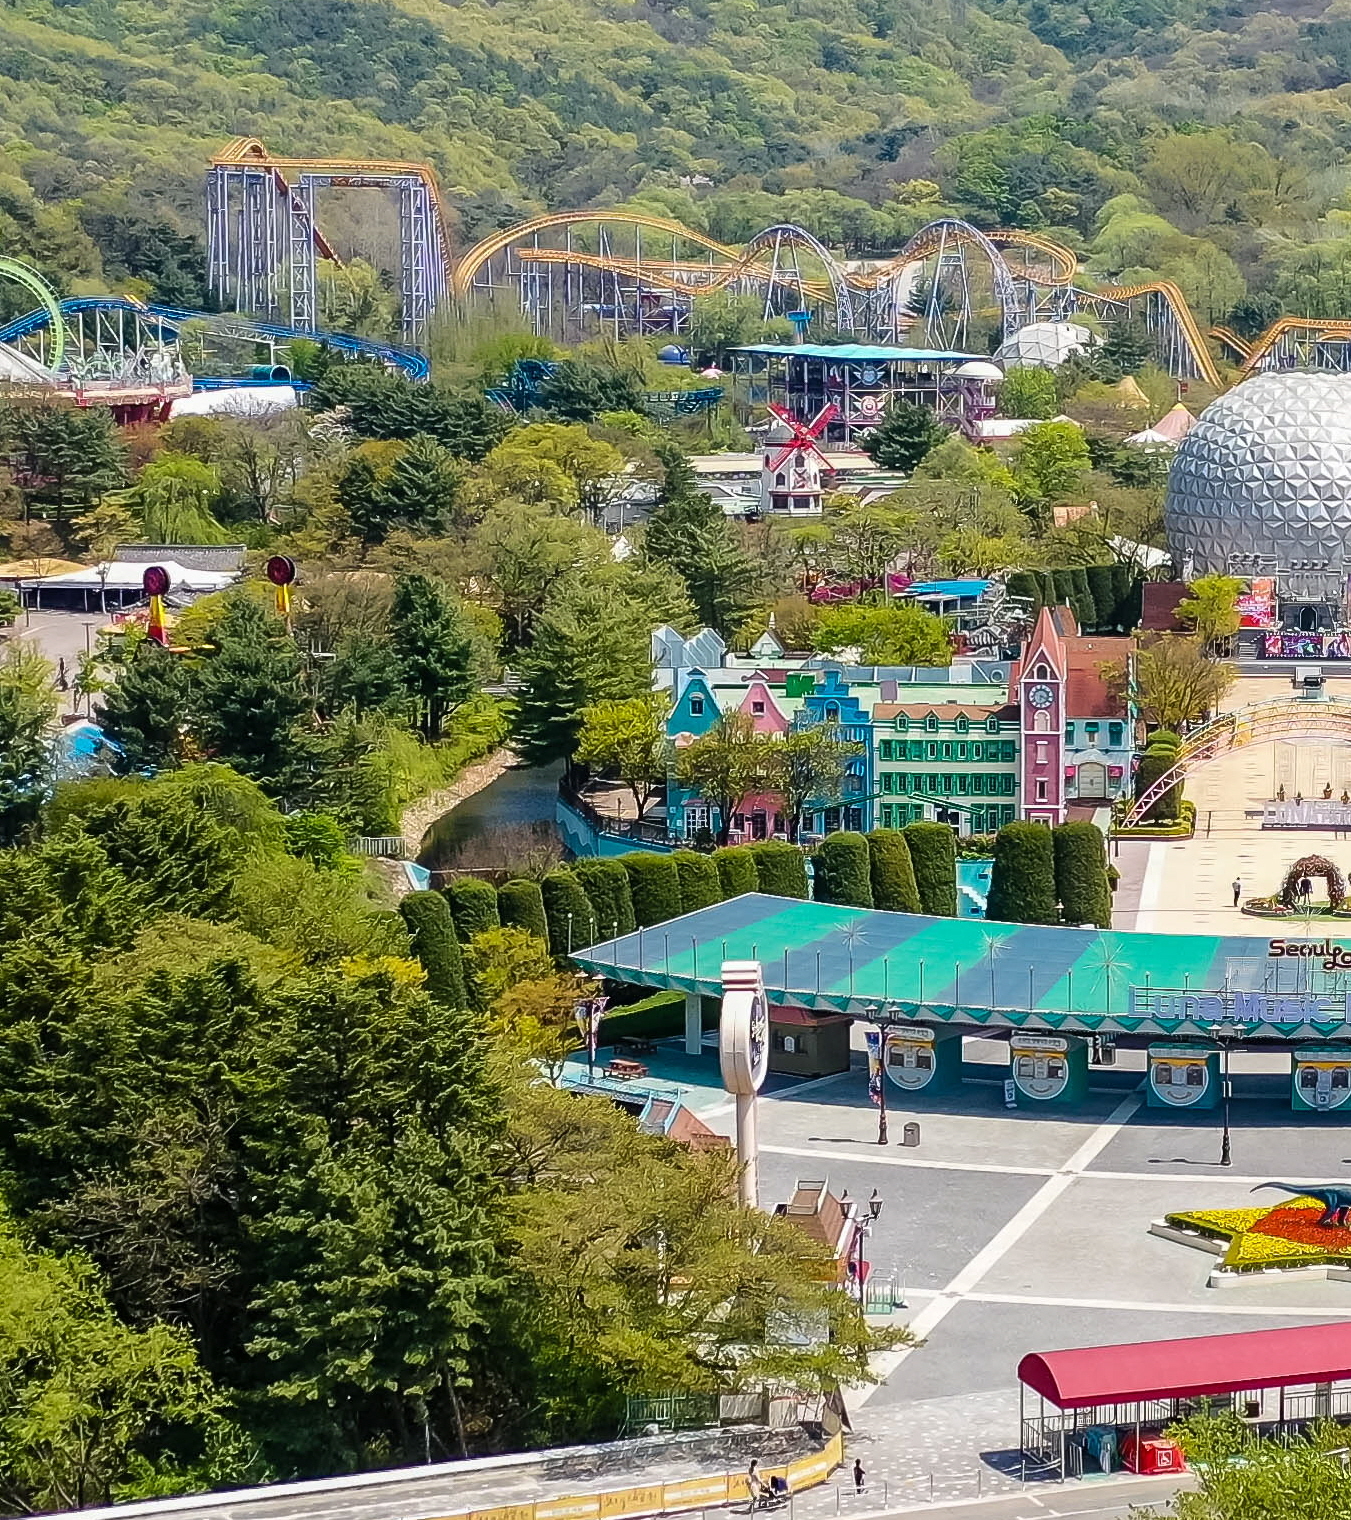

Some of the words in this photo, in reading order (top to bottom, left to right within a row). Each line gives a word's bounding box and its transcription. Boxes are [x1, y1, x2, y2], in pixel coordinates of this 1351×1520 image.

[1268, 938, 1333, 957] Seoul
[1128, 985, 1225, 1020] Luna
[1233, 990, 1333, 1023] Music
